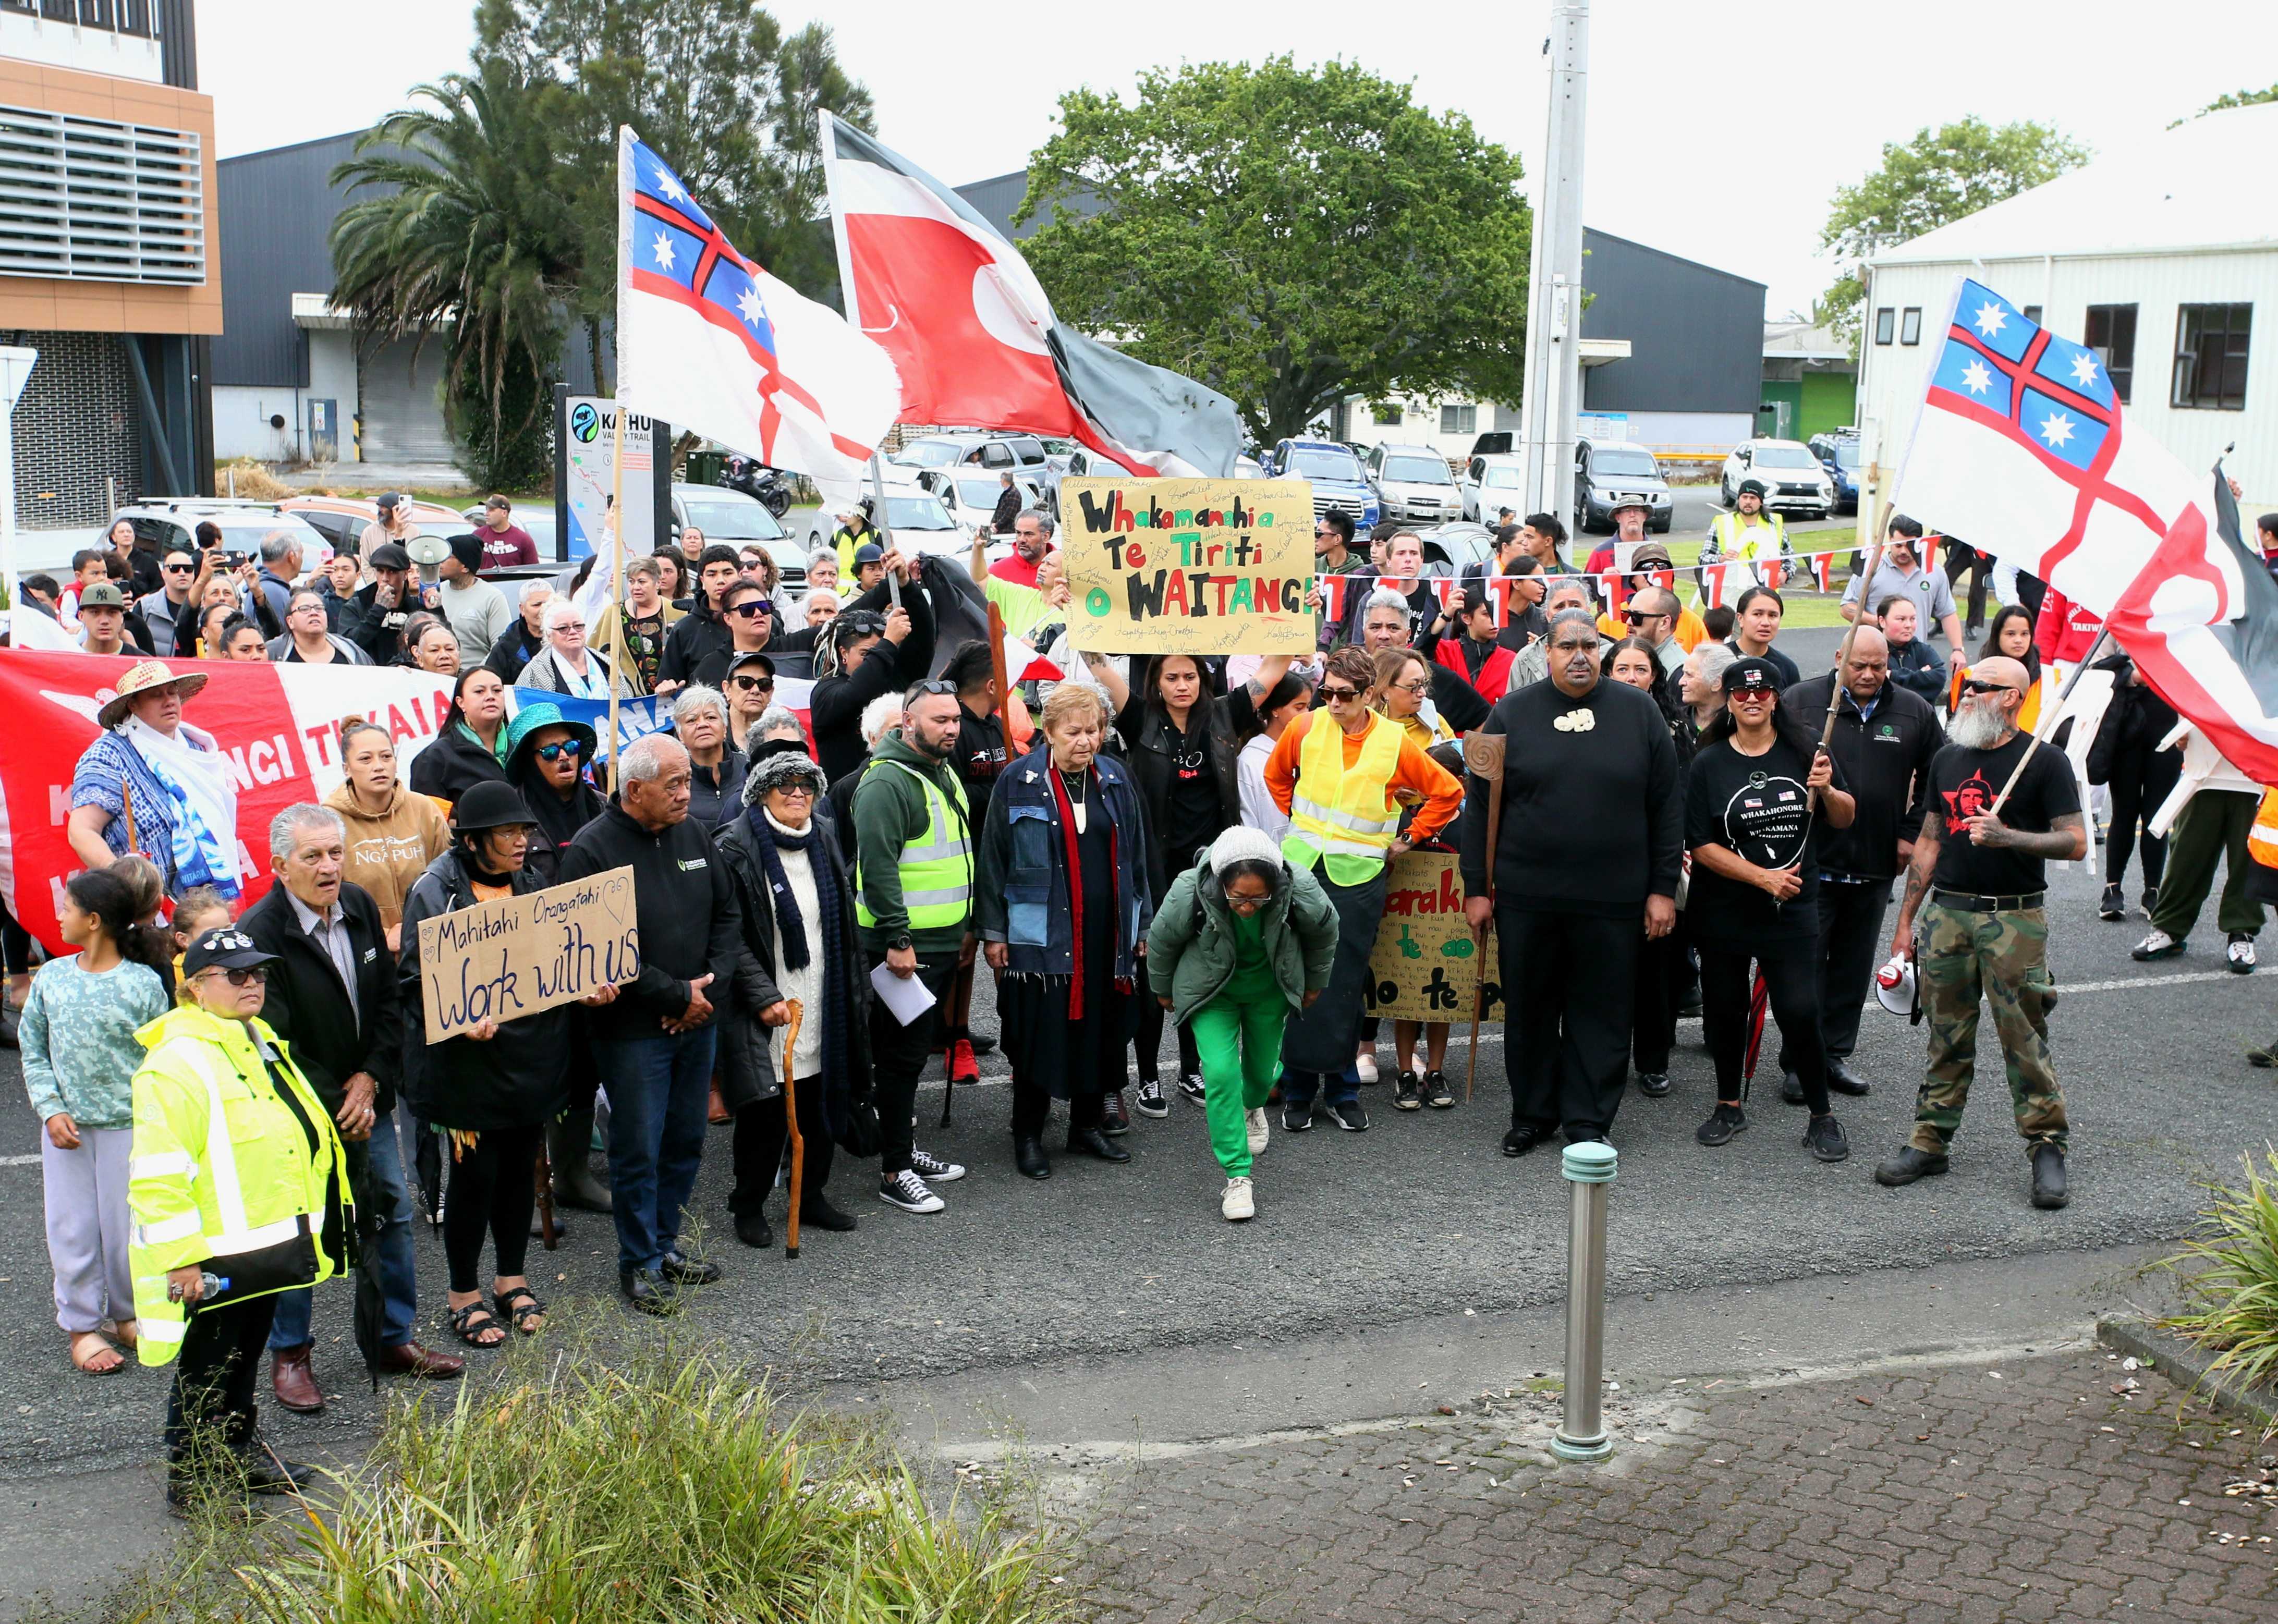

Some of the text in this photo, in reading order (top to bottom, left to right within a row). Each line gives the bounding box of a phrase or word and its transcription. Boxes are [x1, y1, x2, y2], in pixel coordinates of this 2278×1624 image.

[603, 431, 628, 441] VALY
[1078, 490, 1274, 533] Whakamanahia
[1103, 535, 1146, 570] Te
[1171, 532, 1262, 567] Tiriti
[1126, 569, 1312, 622] WAITANGI
[1740, 804, 1804, 820] WHAKAHONORE
[438, 908, 519, 963] Mahitahi
[1395, 924, 1475, 959] te ao
[432, 922, 640, 1030] Work with us
[1421, 967, 1458, 1010] te
